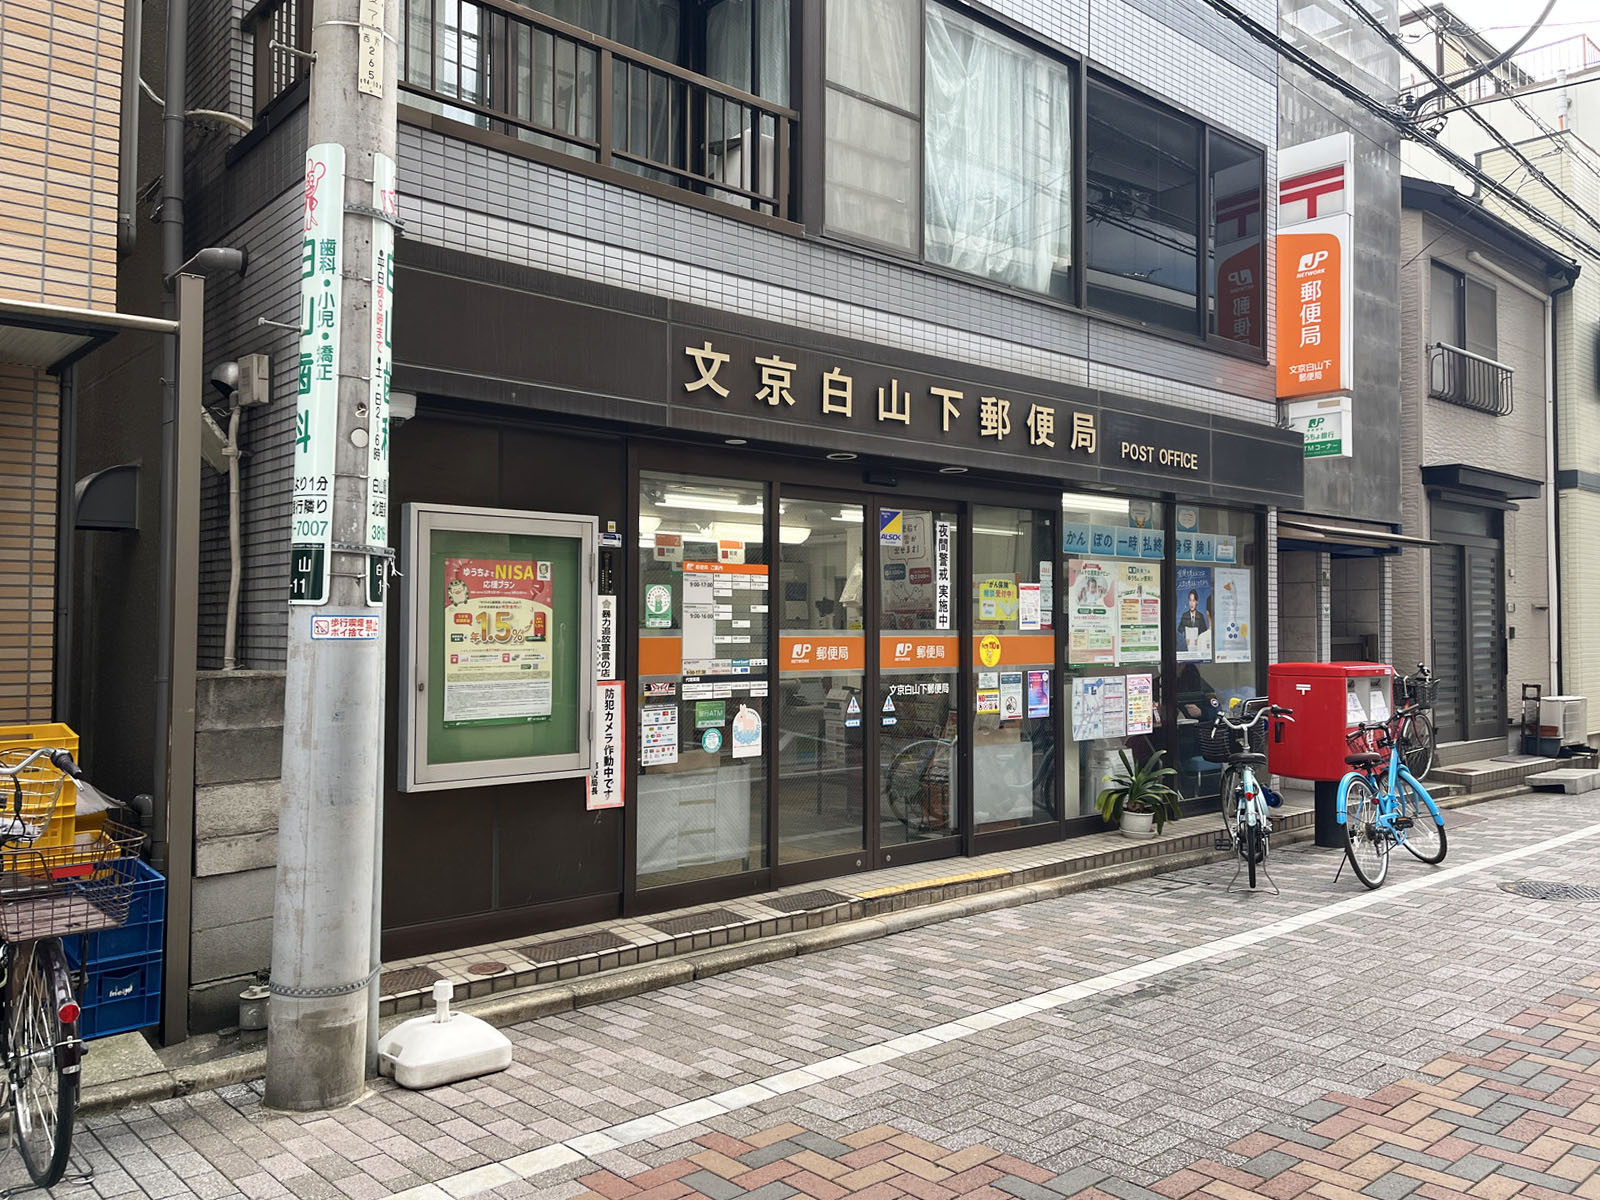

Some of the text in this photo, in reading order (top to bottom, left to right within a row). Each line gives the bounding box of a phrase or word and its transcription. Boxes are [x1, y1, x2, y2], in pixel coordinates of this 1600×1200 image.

[1300, 279, 1322, 348] 郵便局
[1289, 360, 1333, 375] 文京白山下
[684, 341, 1097, 454] 文京白山下郵便局
[1121, 441, 1199, 470] POST OFFICE
[880, 533, 901, 541] ALSOK
[495, 564, 535, 580] NISA
[938, 523, 949, 628] 夜間警戒 実施中
[601, 609, 611, 678] 暴力追放宣言の店
[816, 646, 849, 661] 郵便局
[916, 645, 945, 659] 郵便局
[889, 683, 949, 696] 文京白山下郵便局
[603, 688, 615, 801] 防犯カメラ作動中です
